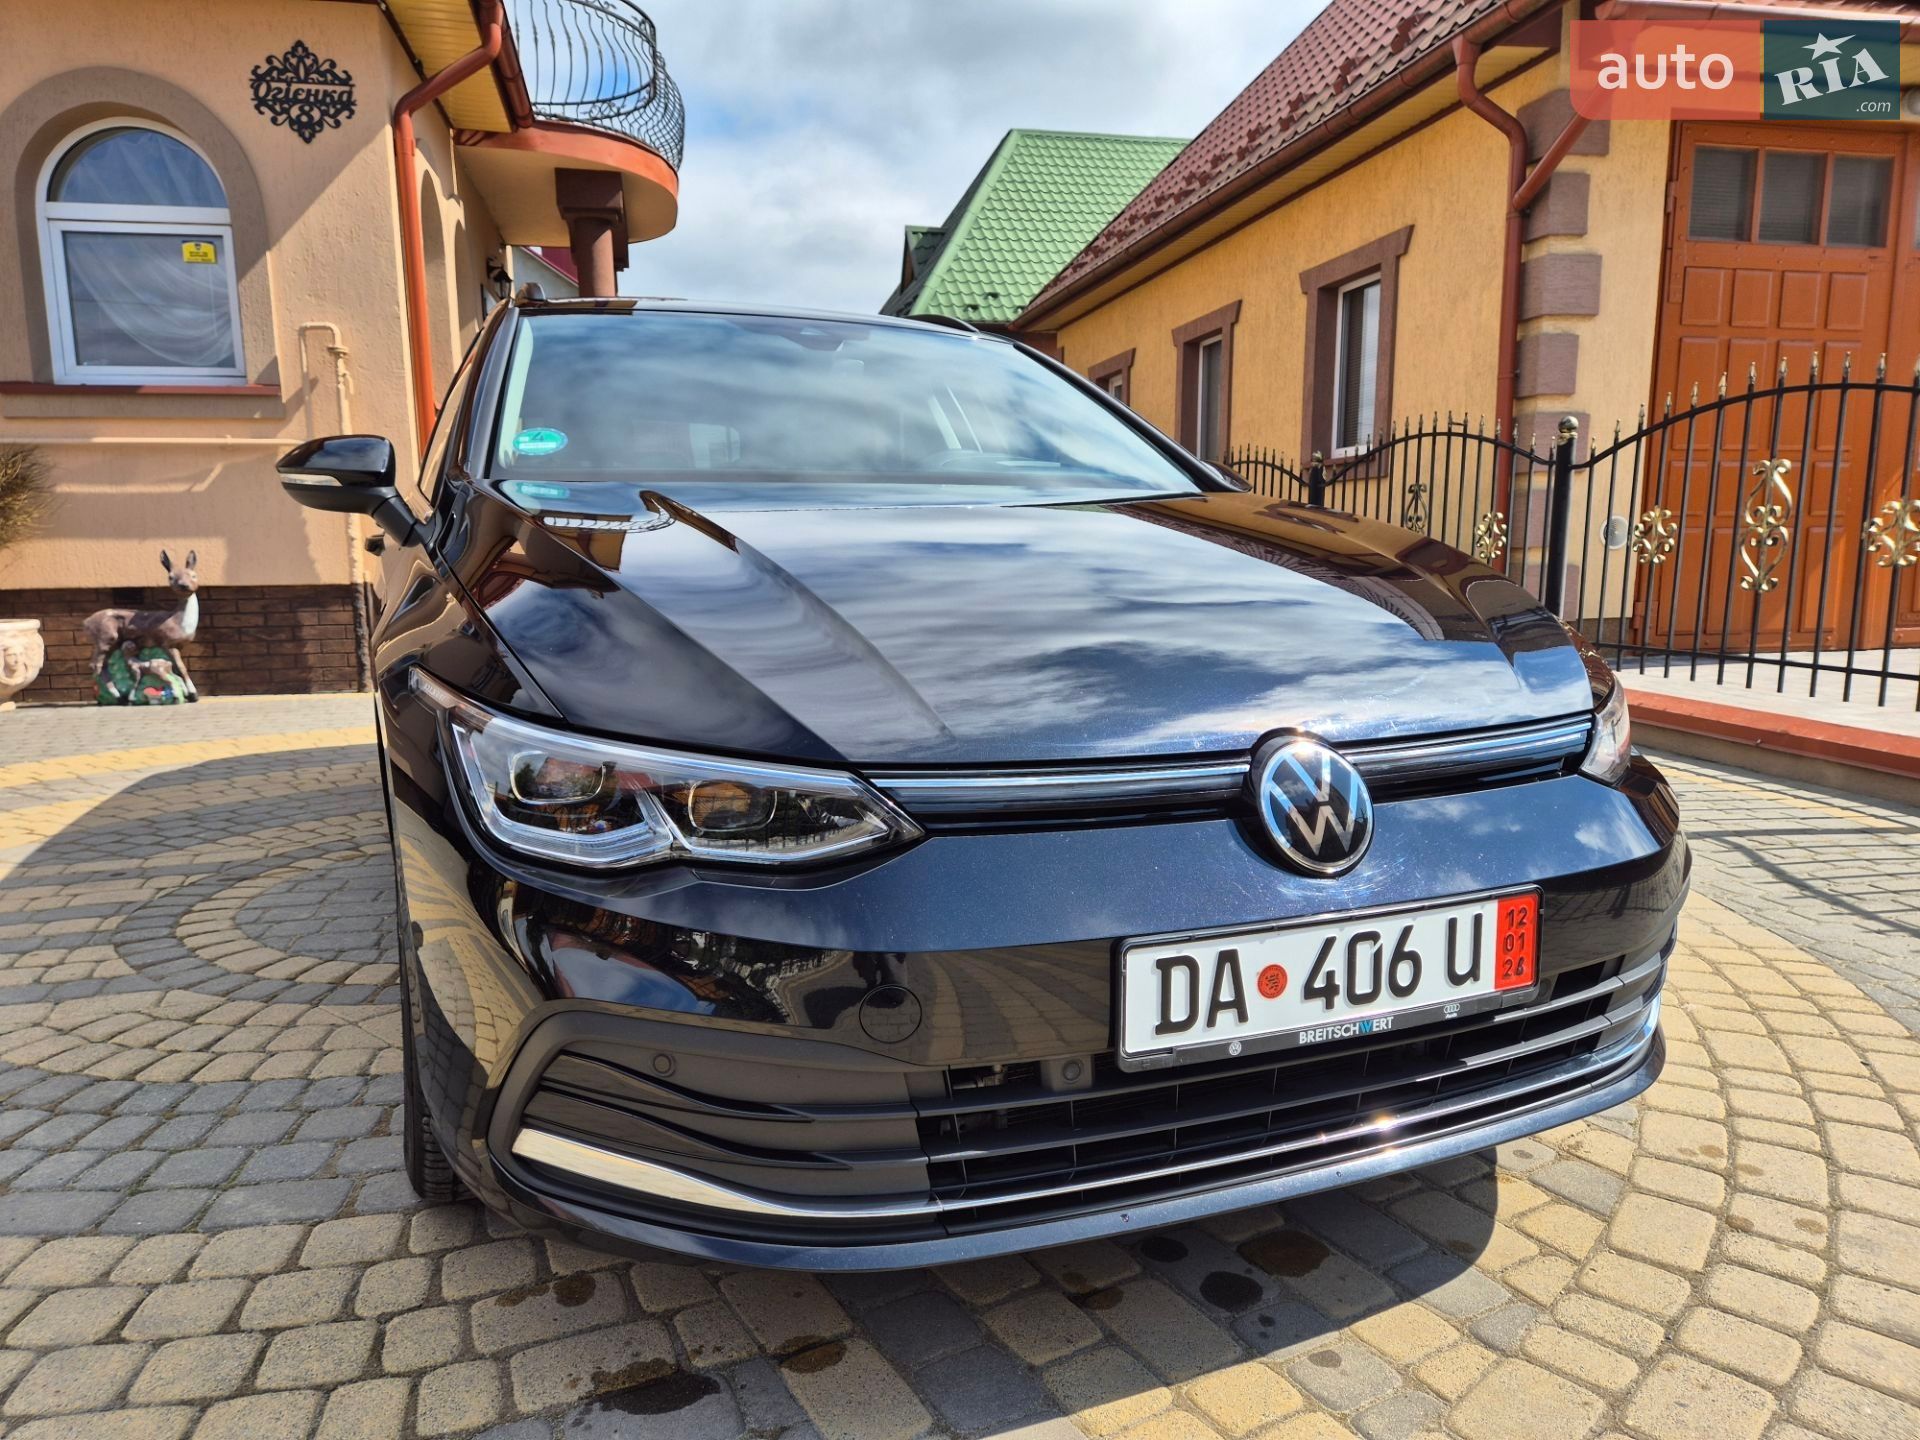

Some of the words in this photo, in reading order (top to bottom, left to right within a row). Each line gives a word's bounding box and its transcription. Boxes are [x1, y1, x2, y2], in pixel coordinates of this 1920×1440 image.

[1506, 907, 1528, 928] 12
[1504, 932, 1526, 953] 01
[1155, 949, 1249, 1036] DA
[1303, 924, 1423, 1011] 406
[1447, 912, 1484, 986] U
[1299, 1016, 1394, 1044] BREITSCHWERT
